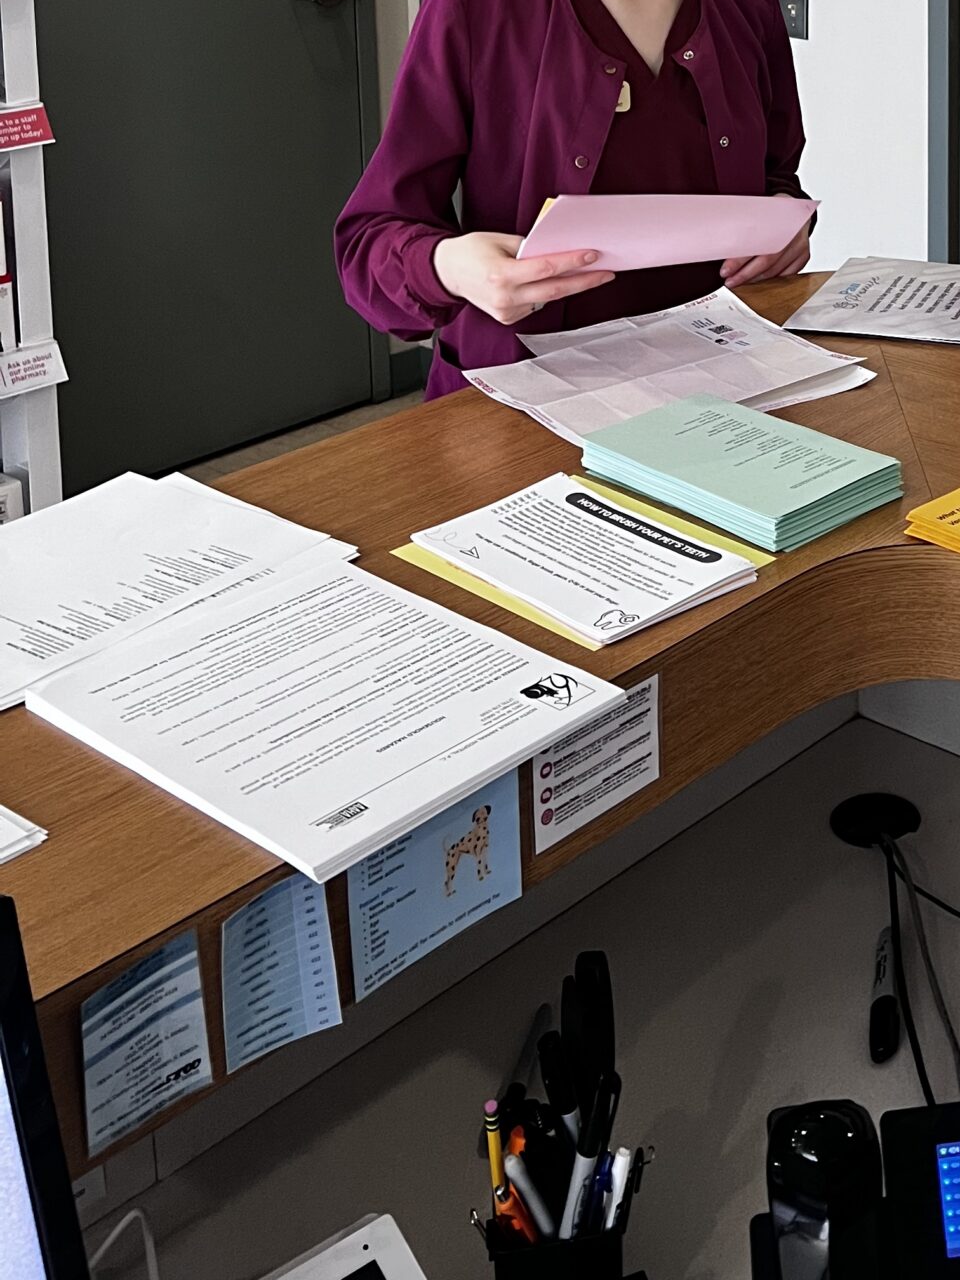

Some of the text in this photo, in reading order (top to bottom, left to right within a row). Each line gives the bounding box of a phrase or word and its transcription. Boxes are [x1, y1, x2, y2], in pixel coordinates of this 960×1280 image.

[20, 114, 37, 123] staff
[0, 125, 22, 135] ember
[20, 128, 44, 139] today!
[7, 352, 52, 370] Ask us about
[23, 362, 45, 373] online
[934, 509, 959, 521] What
[577, 499, 708, 559] HOW TO BRUSH YOUR PET'S TEETH
[373, 714, 448, 754] HOUSEHOLD HAZARDS
[341, 802, 369, 820] AAHA
